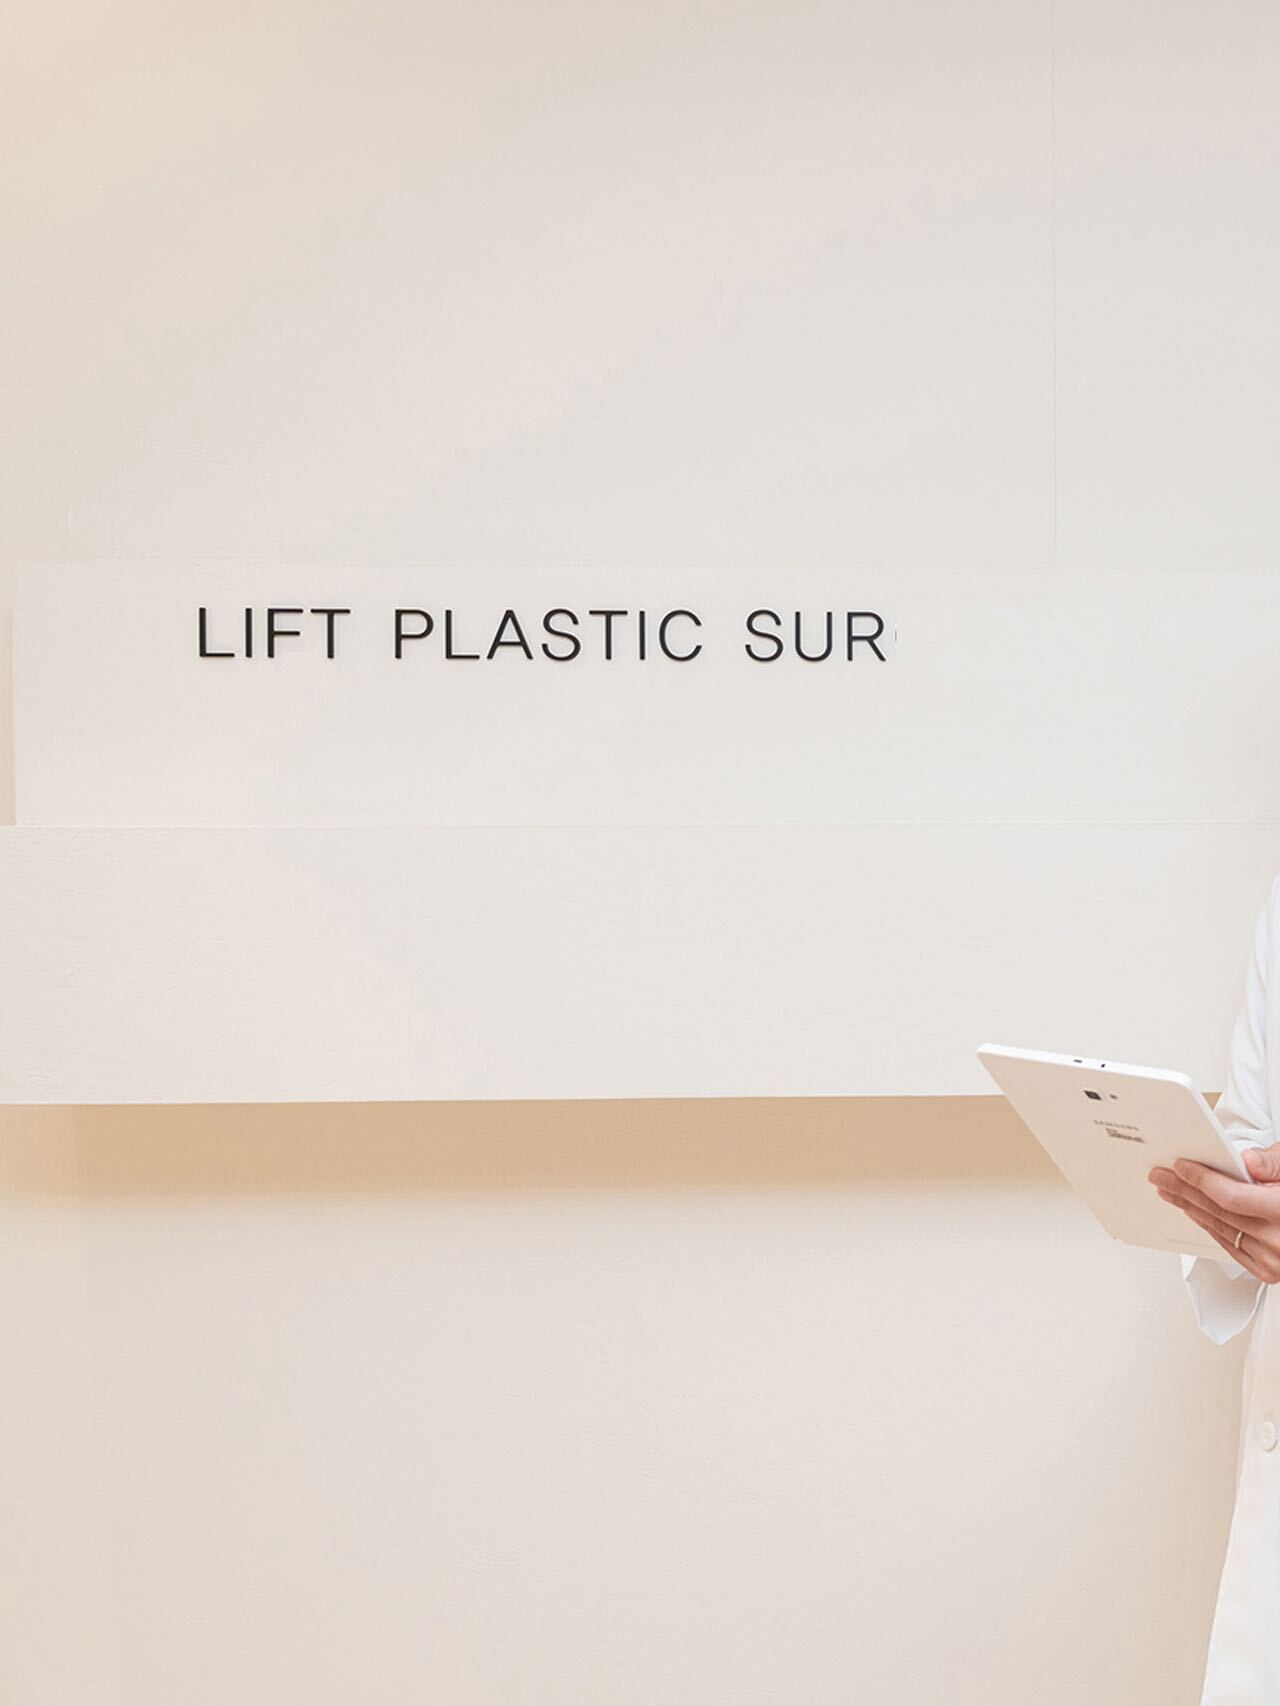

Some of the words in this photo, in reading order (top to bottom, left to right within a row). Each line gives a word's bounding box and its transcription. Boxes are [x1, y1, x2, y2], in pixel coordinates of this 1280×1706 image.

[198, 607, 351, 659] LIFT
[394, 608, 703, 661] PLASTIC
[744, 609, 898, 662] SUR
